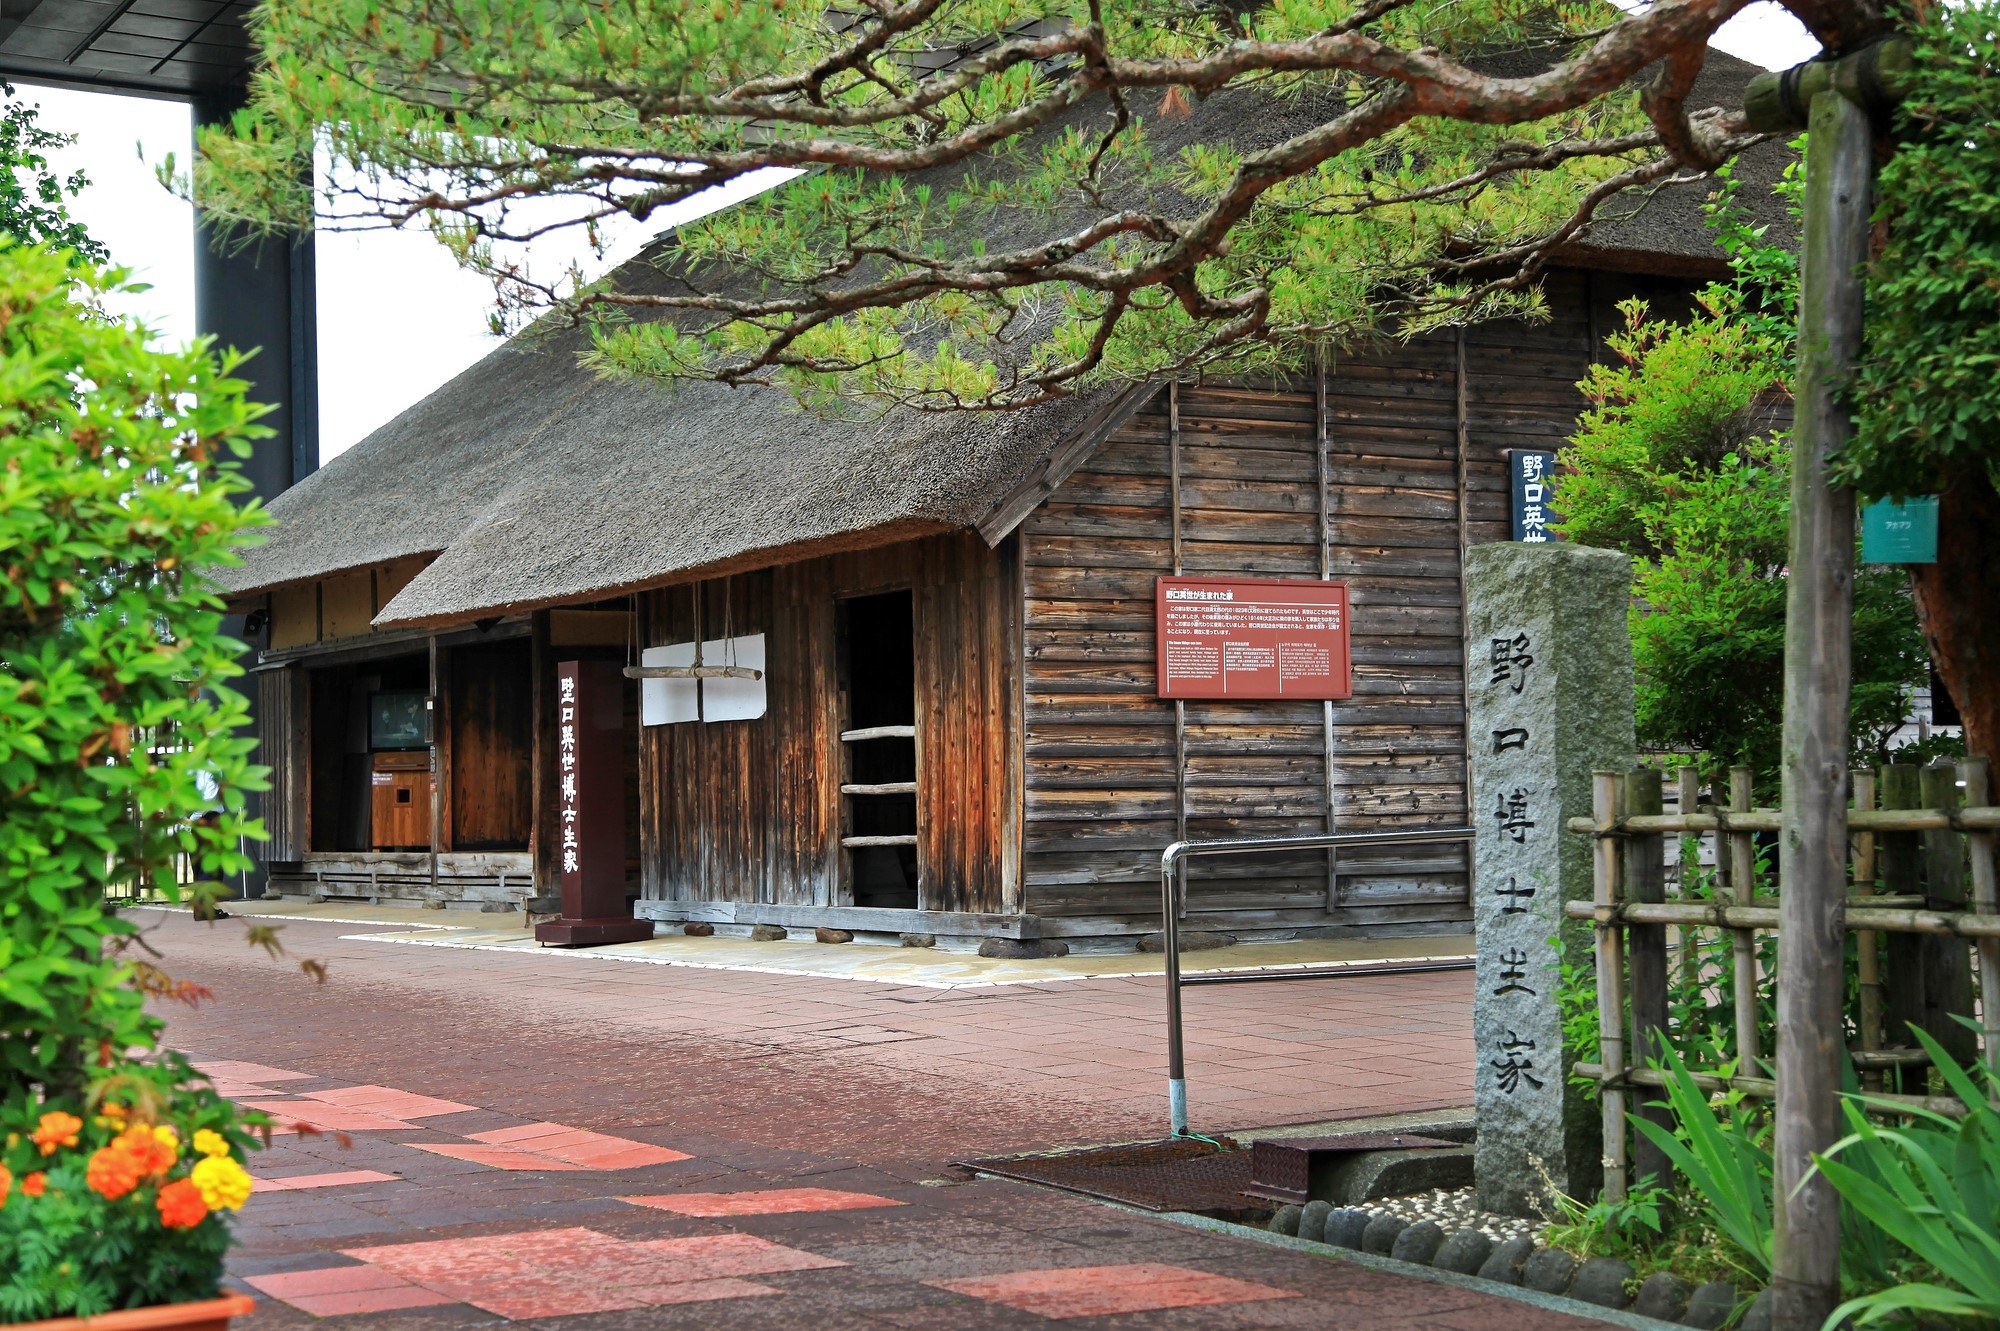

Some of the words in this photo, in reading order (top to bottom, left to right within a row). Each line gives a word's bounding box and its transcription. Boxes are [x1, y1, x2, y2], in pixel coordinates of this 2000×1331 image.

[1885, 521, 1912, 531] アカマツ
[1166, 590, 1233, 600] 野口英世が生まれた家
[1490, 631, 1544, 1094] 野口博士生家
